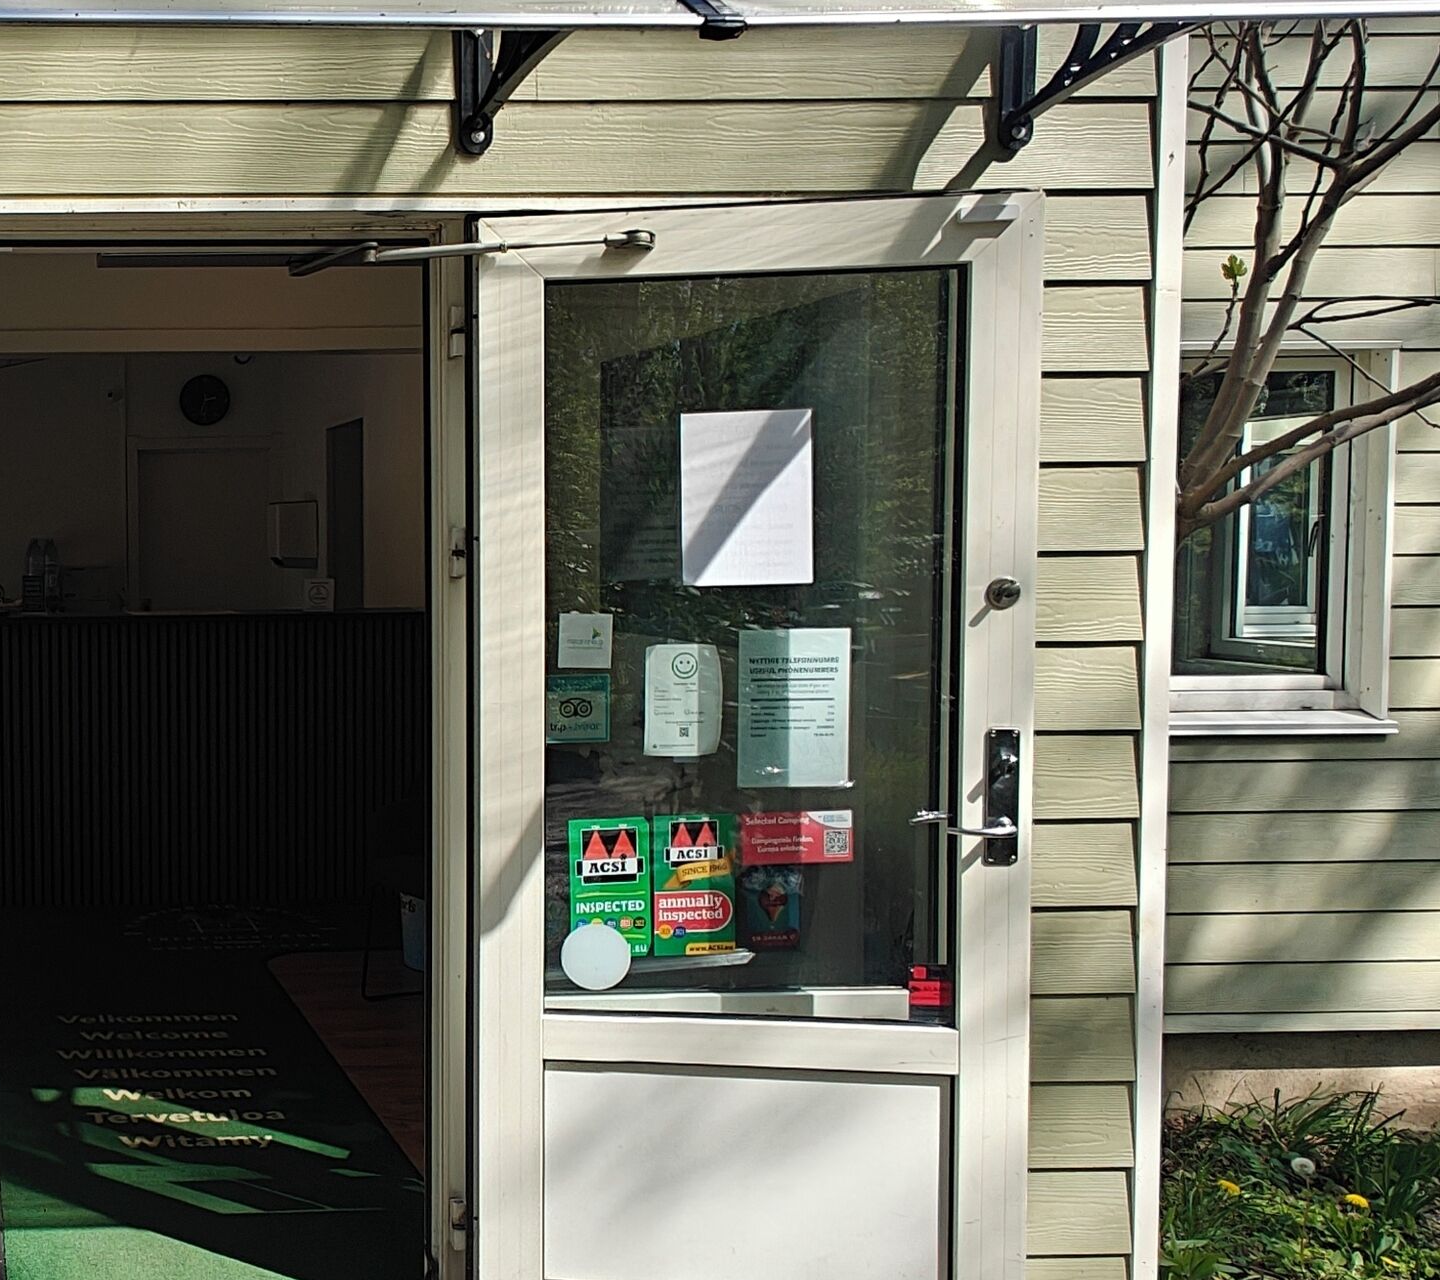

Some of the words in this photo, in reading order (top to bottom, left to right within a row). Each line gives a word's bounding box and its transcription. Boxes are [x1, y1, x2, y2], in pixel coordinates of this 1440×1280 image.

[677, 849, 709, 859] ACSI
[589, 860, 627, 873] ACSI
[681, 866, 708, 877] SINCE
[575, 900, 646, 915] INSPECTED
[658, 894, 724, 910] annually
[658, 908, 724, 923] inspected
[58, 1013, 240, 1024] Velkommen
[80, 1029, 230, 1040] Welcome
[56, 1047, 268, 1060] Willkommen
[74, 1066, 279, 1080] Välkommen
[102, 1087, 253, 1101] Welkom
[86, 1109, 287, 1125] Tervetuloa
[118, 1135, 273, 1149] Witamy
